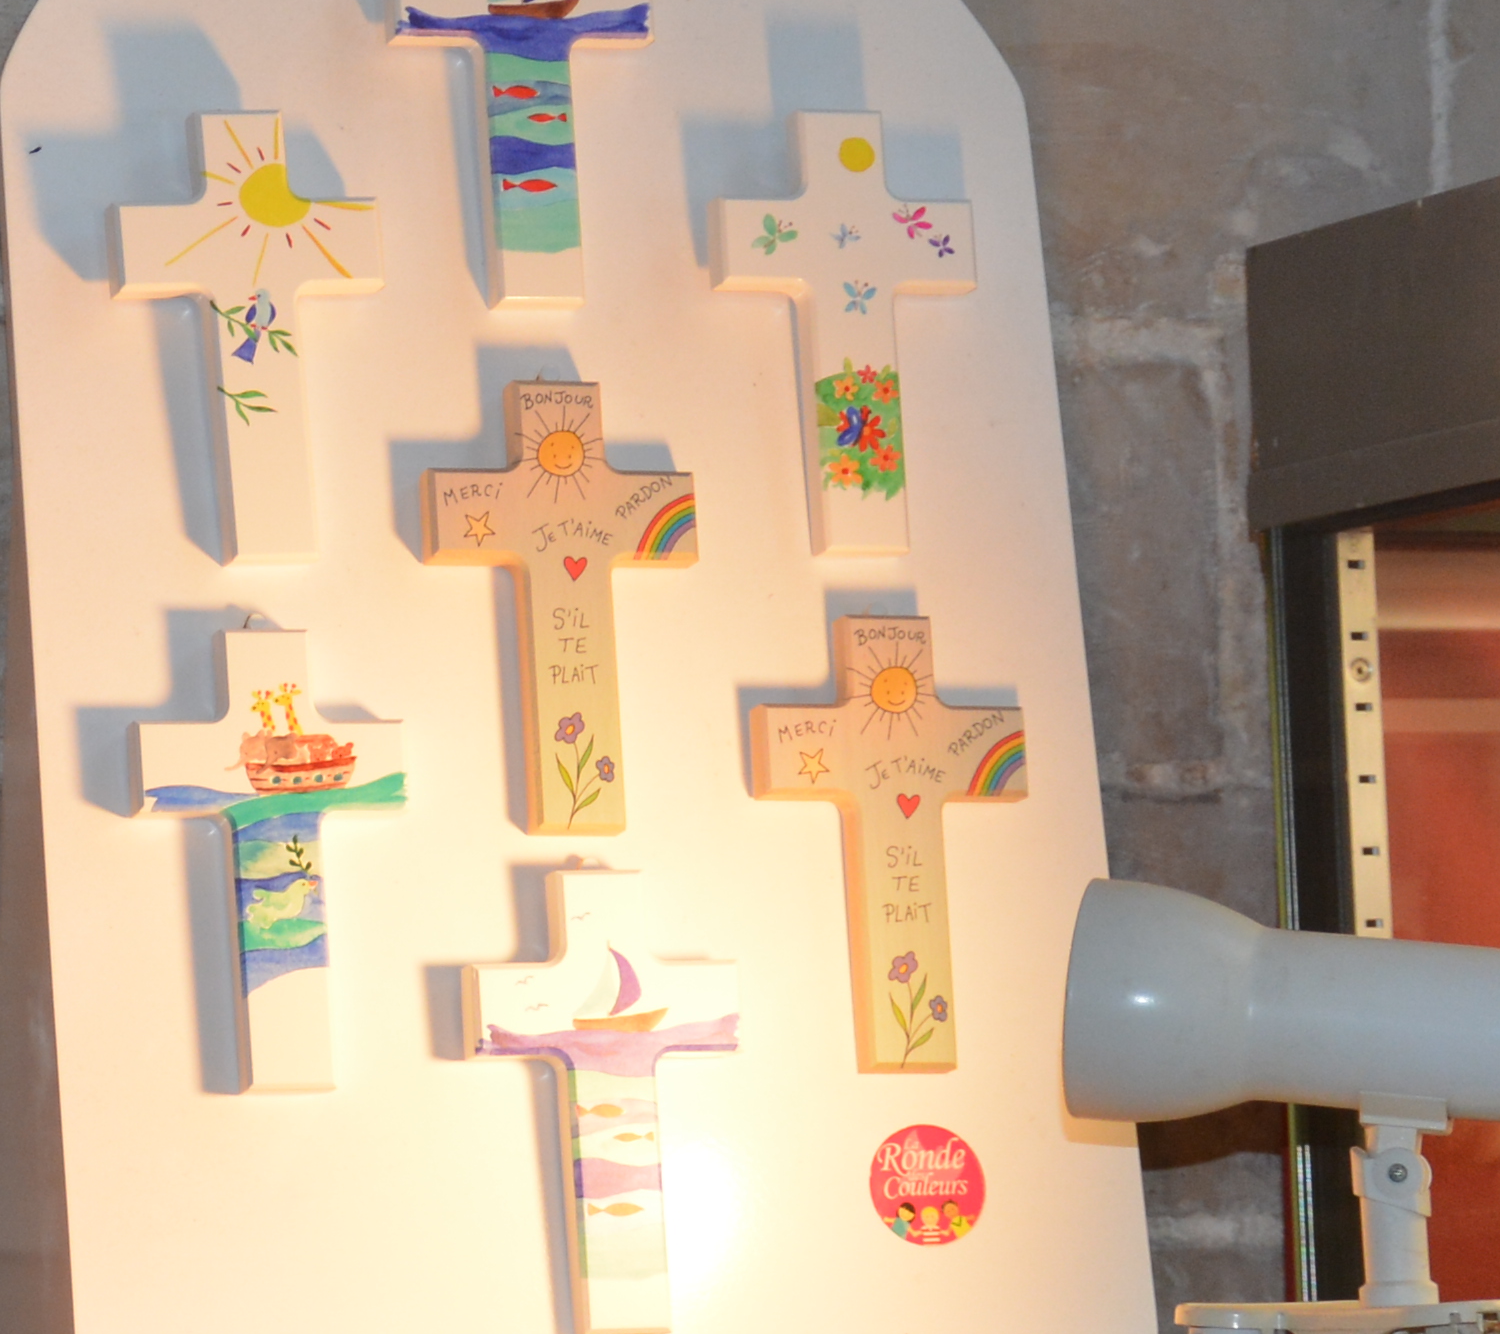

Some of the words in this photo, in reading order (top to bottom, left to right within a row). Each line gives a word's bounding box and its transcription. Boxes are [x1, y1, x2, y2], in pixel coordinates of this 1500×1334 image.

[520, 390, 593, 410] BONJOUR
[615, 475, 673, 520] PARDON
[558, 637, 587, 654] TE
[854, 625, 927, 646] BONJOUR
[947, 710, 1005, 757] PARDON
[891, 875, 920, 892] TE
[877, 1137, 967, 1177] Ronde
[883, 1171, 969, 1200] Couleurs
